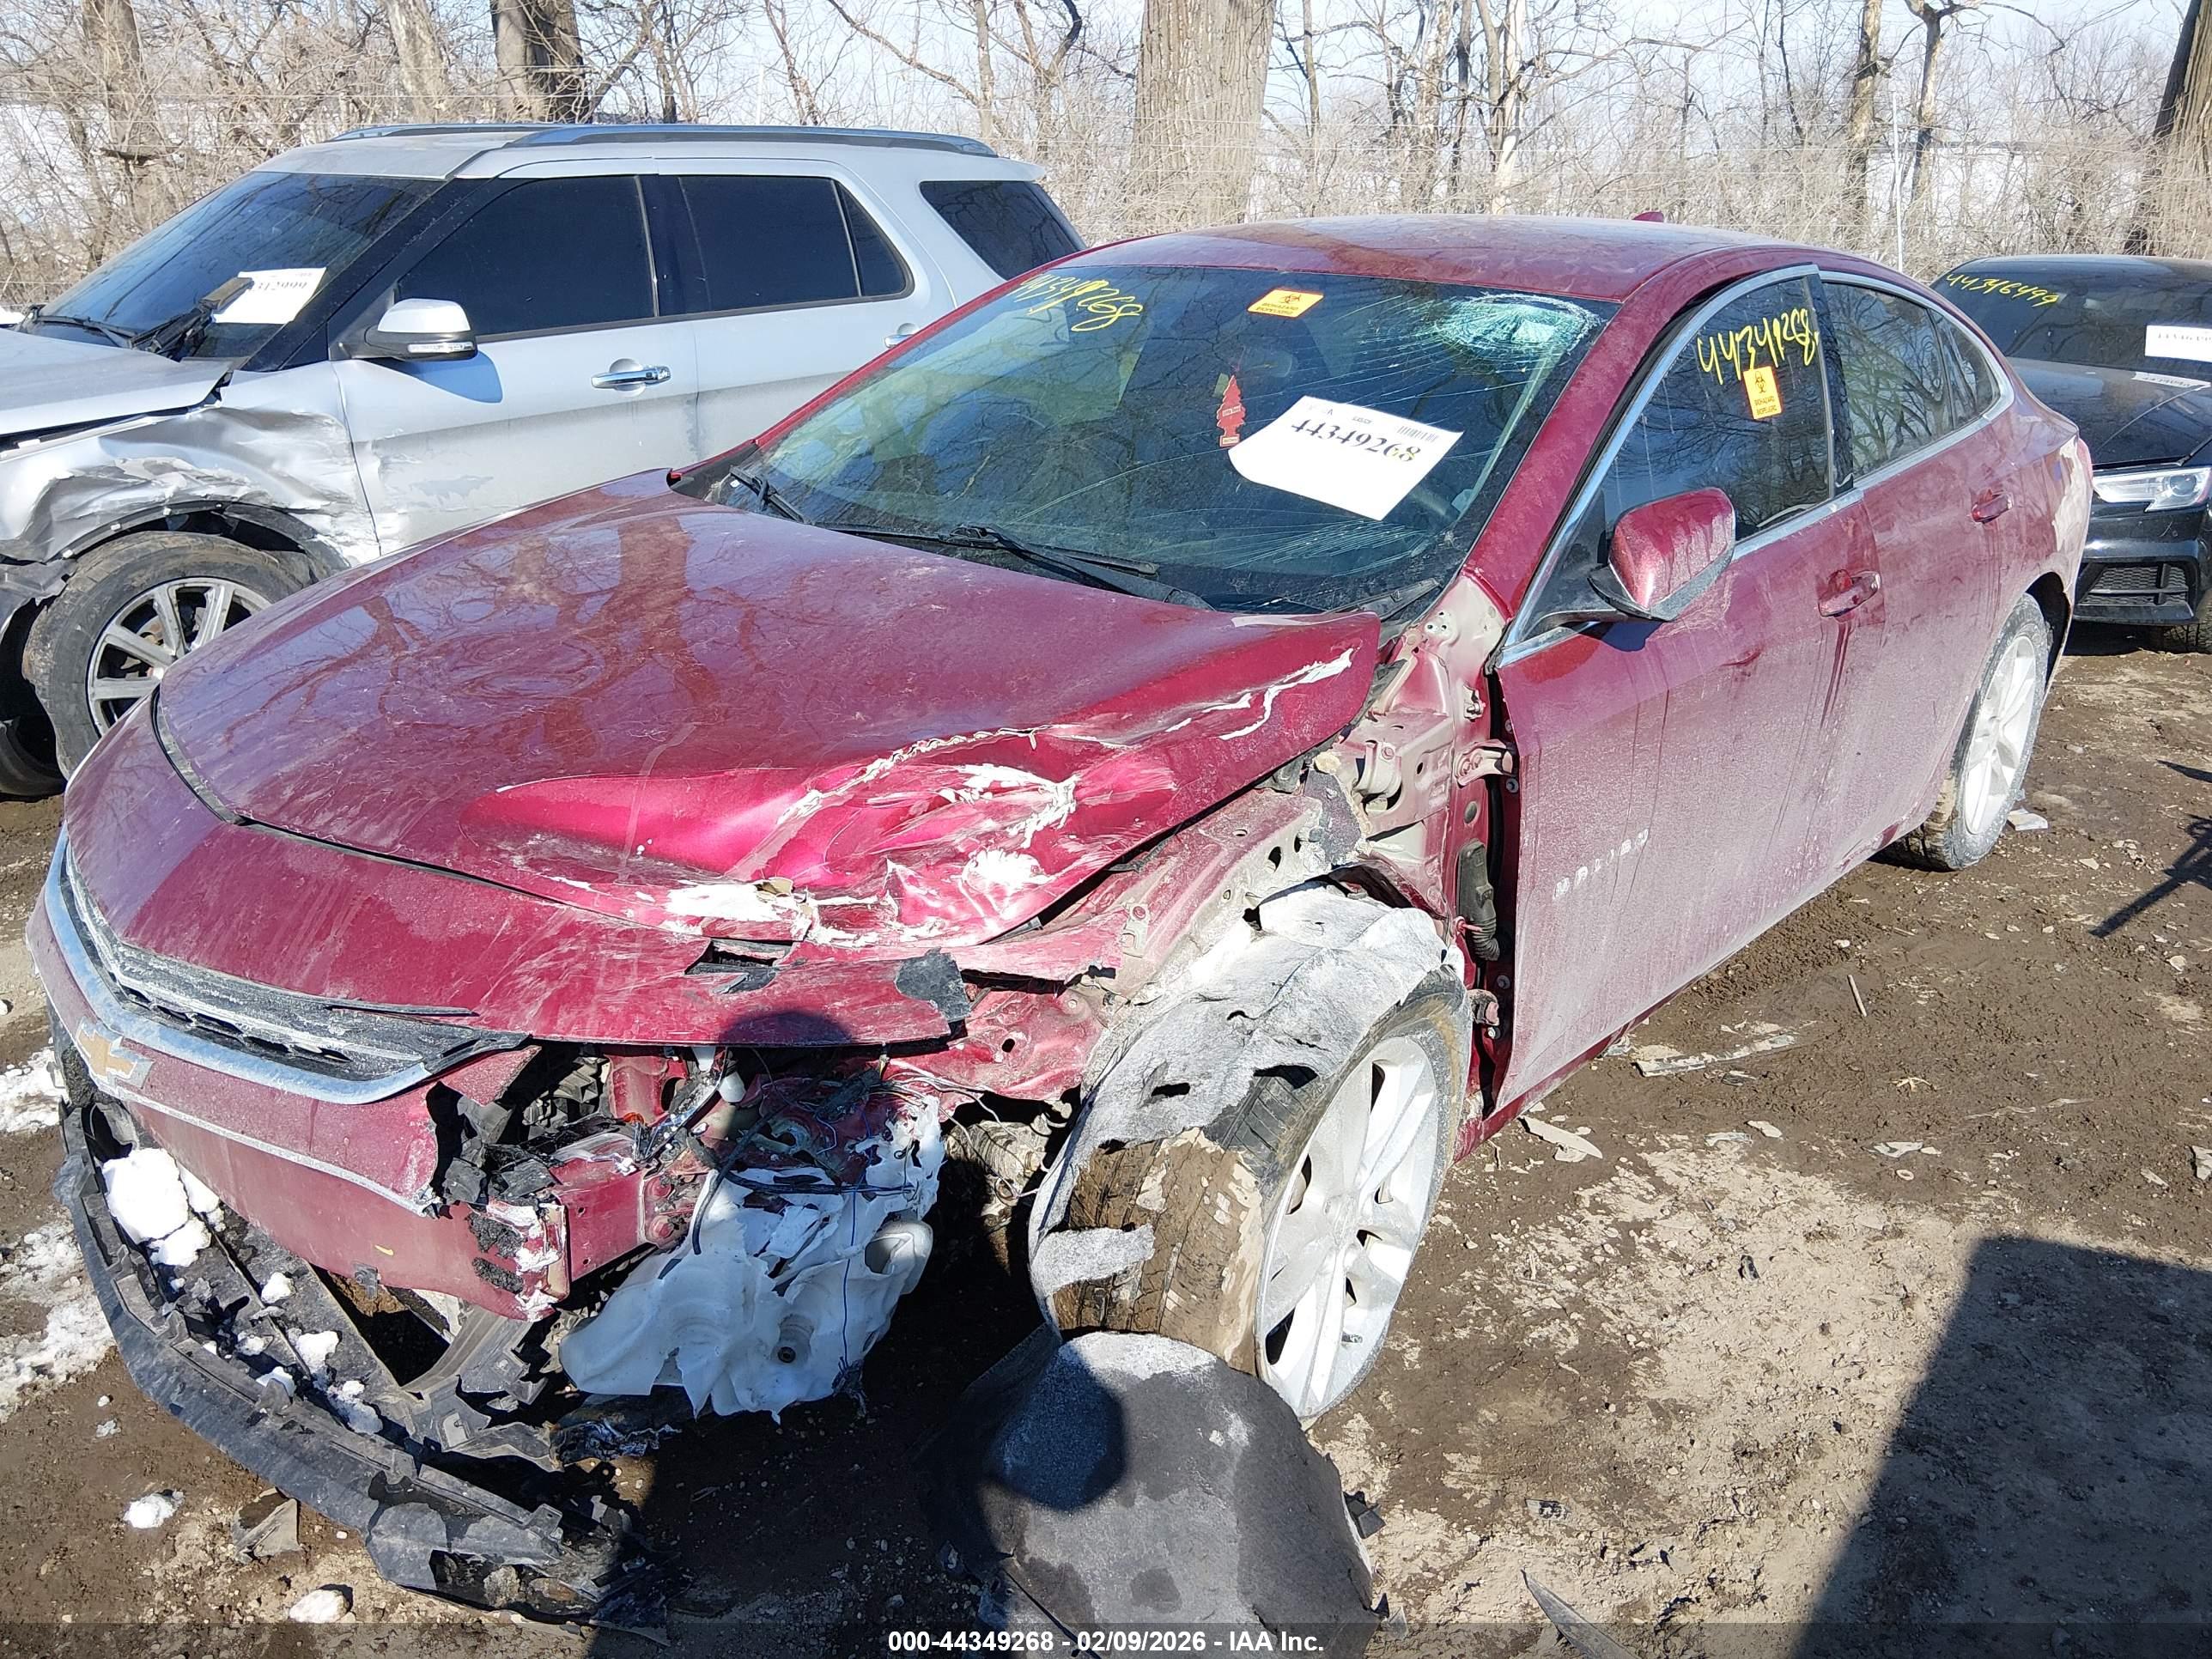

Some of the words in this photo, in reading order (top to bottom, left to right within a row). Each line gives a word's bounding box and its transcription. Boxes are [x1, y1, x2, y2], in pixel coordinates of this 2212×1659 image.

[1261, 301, 1299, 311] BIOHAZARD
[1945, 273, 2061, 307] 44346499
[1291, 418, 1421, 462] 44349268
[1553, 829, 1649, 900] MALIBU
